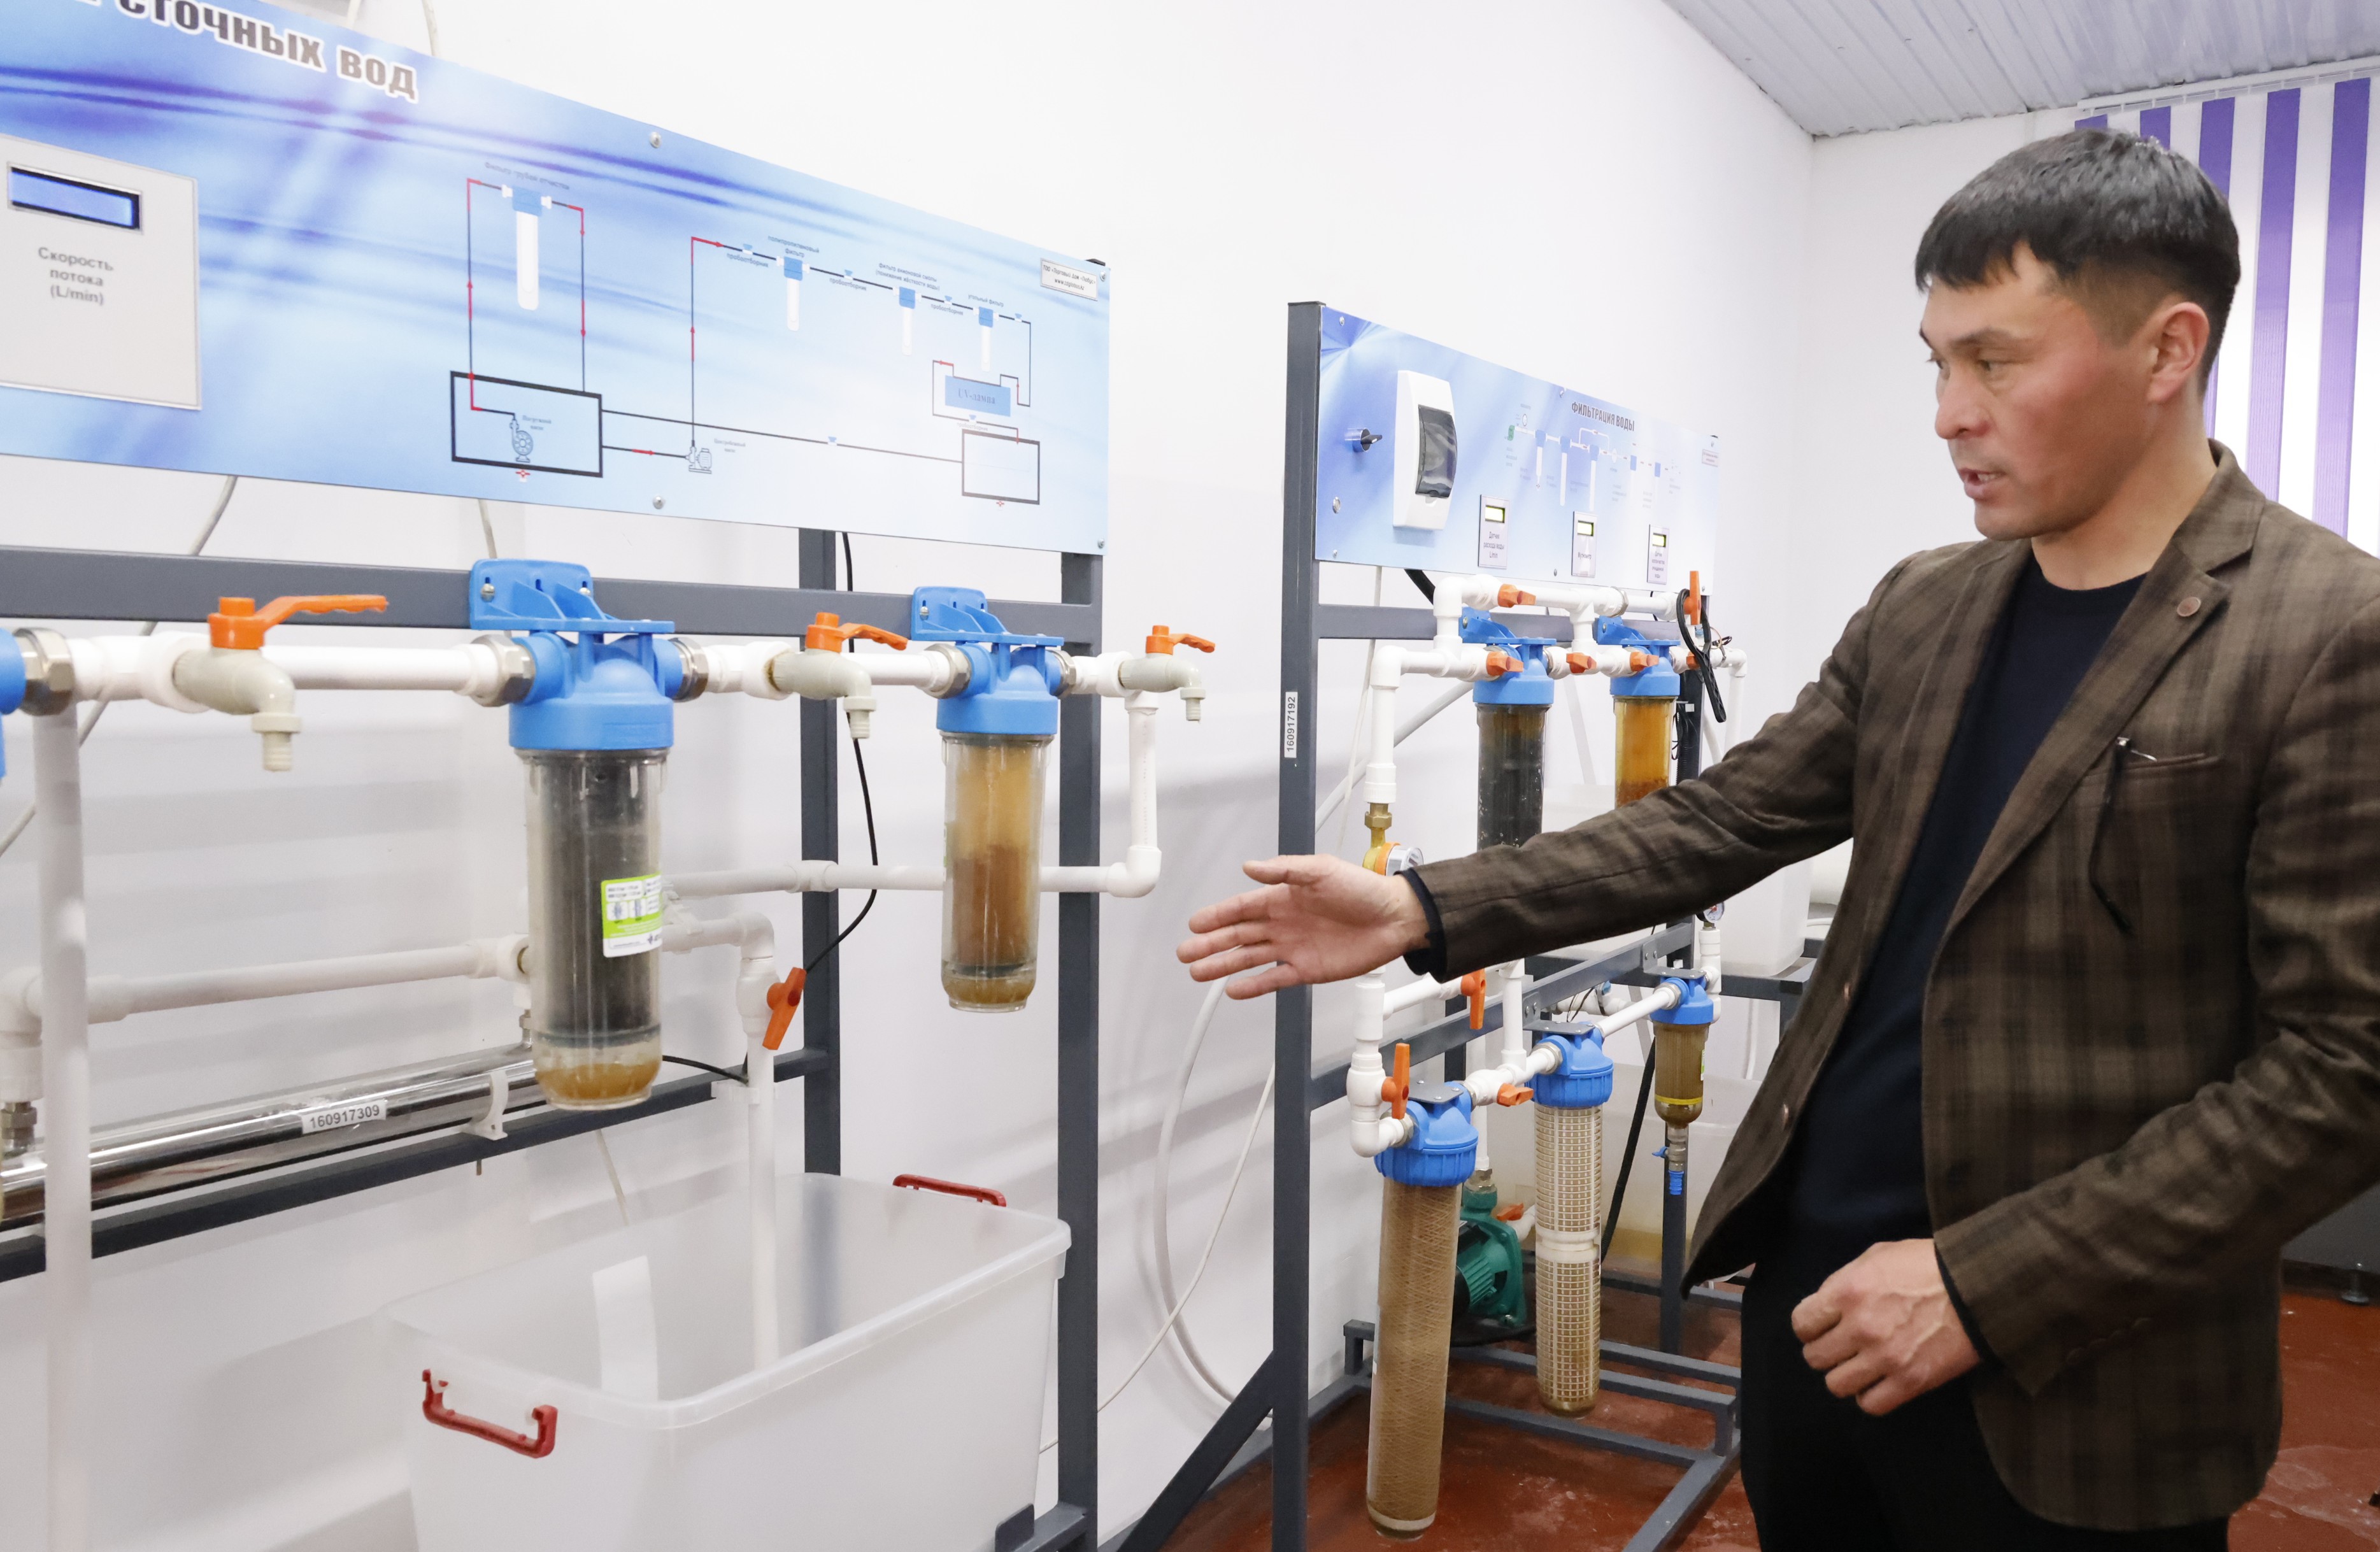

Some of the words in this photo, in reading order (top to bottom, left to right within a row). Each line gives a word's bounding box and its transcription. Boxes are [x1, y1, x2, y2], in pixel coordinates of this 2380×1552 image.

[38, 246, 114, 271] Скорость
[879, 262, 896, 272] фильтр
[50, 269, 103, 287] потока
[876, 269, 902, 281] (понижение
[903, 276, 926, 287] жёсткости
[927, 283, 940, 291] воды)
[51, 284, 103, 306] (L/min)
[968, 294, 988, 303] угольный
[989, 299, 1004, 308] фильтр
[958, 388, 996, 404] UV-лампа
[1571, 401, 1615, 426] ФИЛЬТРАЦИЯ
[1616, 415, 1635, 432] ВОДЫ
[1286, 697, 1295, 752] 160917192
[310, 1104, 380, 1128] 160917309
